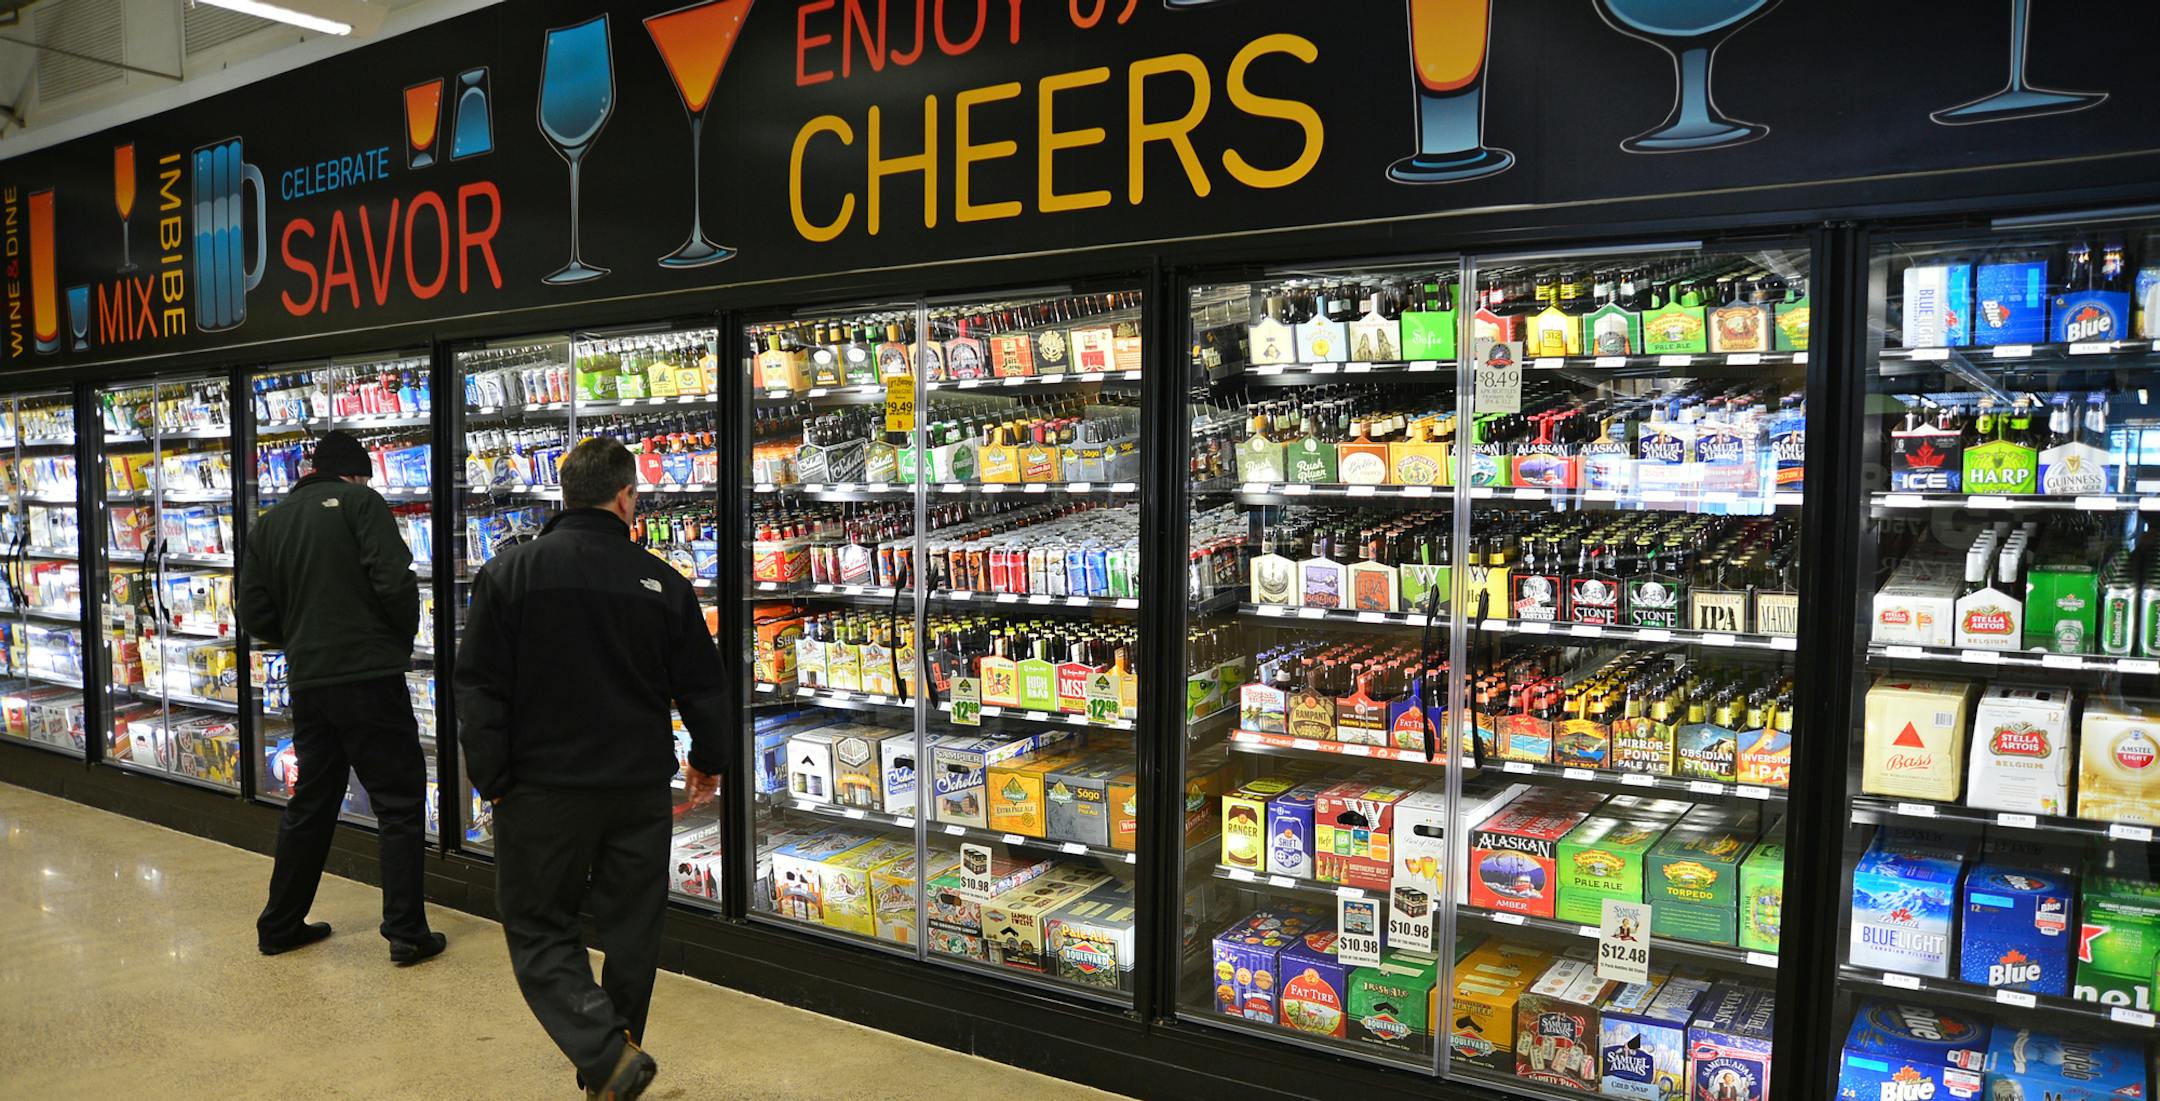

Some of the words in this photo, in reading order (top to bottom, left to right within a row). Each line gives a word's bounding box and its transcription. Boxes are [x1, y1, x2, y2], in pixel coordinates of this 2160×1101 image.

[789, 34, 1324, 242] CHEERS
[281, 148, 390, 201] CELEBRATE
[5, 185, 18, 257] DINE
[159, 153, 186, 337] IMBIBE
[281, 181, 502, 316] SAVOR
[6, 258, 19, 279] &
[98, 274, 158, 345] MIX
[1982, 300, 2002, 328] Blue
[5, 281, 23, 358] WINE
[2067, 315, 2112, 342] Blue
[1479, 371, 1519, 388] $8.49
[888, 401, 913, 413] $9.49
[1516, 444, 1569, 456] ALASKAN
[1581, 443, 1631, 456] ALASKAN
[1641, 442, 1683, 454] SAMUEL
[1700, 442, 1743, 454] SAMUEL
[1645, 450, 1679, 462] ADAMS
[1297, 458, 1324, 472] Rush
[1902, 473, 1948, 488] ICE
[1970, 466, 2029, 483] HARP
[2047, 474, 2102, 489] GUINNESS
[1574, 607, 1616, 626] STONE
[1632, 609, 1677, 628] STONE
[1700, 606, 1737, 631] IPA
[1971, 615, 2005, 624] STELLA
[1971, 622, 2006, 630] ARTOIS
[2112, 610, 2123, 645] Heineken
[1296, 709, 1327, 720] RAMPANT
[2047, 711, 2060, 722] 12
[1400, 719, 1412, 727] FAT
[1618, 738, 1665, 750] MIRROR
[2000, 733, 2039, 744] STELLA
[1680, 747, 1733, 762] OBSIDIAN
[2000, 742, 2040, 752] ARTOIS
[2120, 745, 2152, 754] AMSTEL
[936, 750, 982, 763] SAMPLER
[1624, 749, 1660, 762] POND
[1886, 752, 1934, 770] Bass
[2122, 752, 2148, 762] LIGHT
[1618, 760, 1643, 770] PALE
[1645, 761, 1665, 772] ALE
[1684, 758, 1730, 773] STOUT
[1995, 760, 2044, 769] BELGIUM
[1749, 764, 1788, 781] IPA
[937, 770, 983, 793] Schell's
[1343, 798, 1385, 831] W
[1228, 822, 1258, 838] RANGER
[1278, 838, 1298, 848] SHIFT
[1477, 833, 1552, 859] ALASKAN
[961, 876, 989, 893] $10.98
[1575, 878, 1600, 888] PALE
[1603, 881, 1623, 891] ALE
[1666, 887, 1713, 900] TORPEDO
[1496, 899, 1528, 910] AMBER
[1970, 904, 1981, 913] 12
[2041, 902, 2061, 912] Blue
[1011, 911, 1033, 921] SAMPLE
[1011, 918, 1034, 927] TWELVE
[1877, 913, 1919, 928] Labatt
[1062, 924, 1087, 940] Pale
[1088, 931, 1111, 944] Ale
[1390, 919, 1429, 939] $10.98
[1340, 936, 1378, 954] $10.98
[1065, 947, 1108, 967] BOULEVARD
[1601, 942, 1647, 964] $12.48
[1989, 963, 2041, 986] Blue
[1291, 984, 1308, 998] FAT
[1311, 989, 1334, 1003] TIRE
[1367, 1017, 1405, 1034] BOULEVARD
[1541, 1017, 1574, 1031] SAMUEL
[1450, 1034, 1490, 1051] BOULEVARD
[1607, 1052, 1650, 1069] SAMUEL
[1609, 1062, 1646, 1077] ADAMS
[1702, 1058, 1731, 1078] SAMUEL
[1731, 1059, 1757, 1087] ADAMS
[1611, 1081, 1629, 1091] COLD
[1631, 1084, 1649, 1093] SNAP
[1880, 1081, 1936, 1101] Blue
